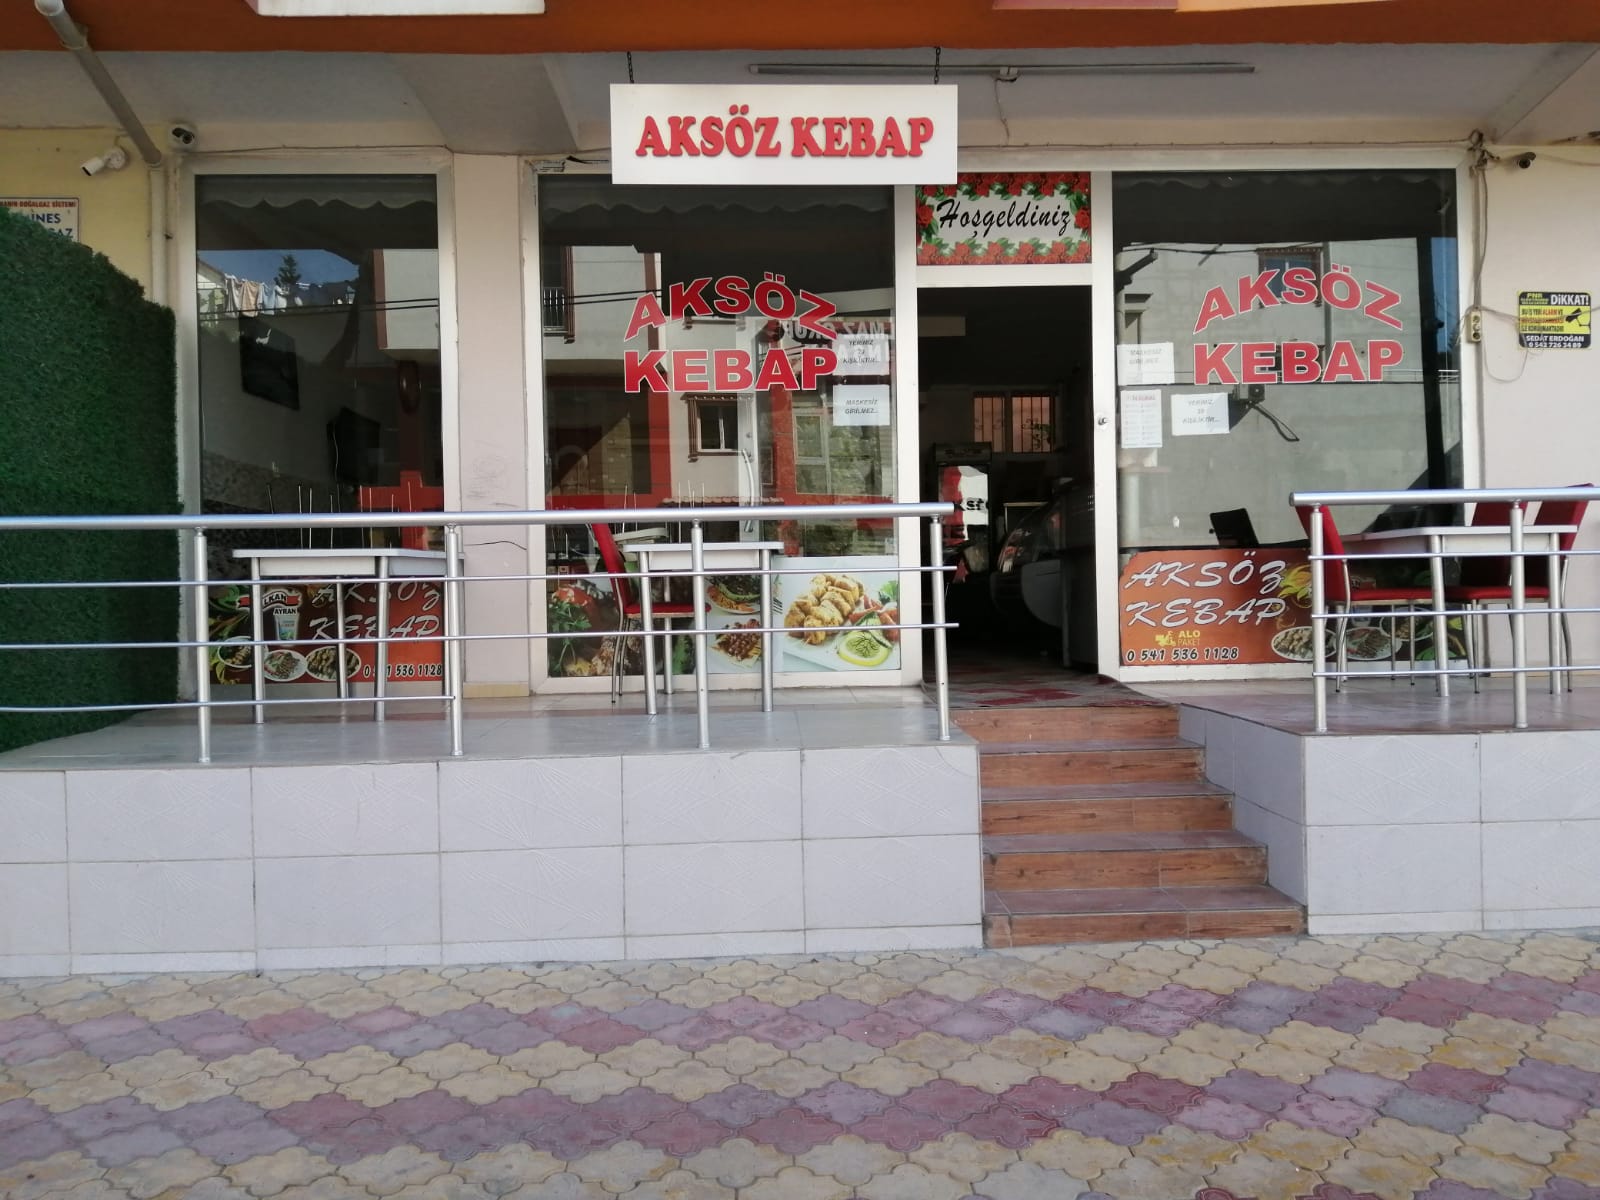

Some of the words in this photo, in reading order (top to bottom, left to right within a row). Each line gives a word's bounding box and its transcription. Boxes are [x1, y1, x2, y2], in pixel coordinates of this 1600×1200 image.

[635, 104, 782, 158] AKSÖZ
[790, 116, 934, 158] KEBAP
[936, 198, 1071, 239] Hoşgeldiniz
[623, 271, 838, 343] AKSÖZ
[1192, 263, 1403, 335] AKSÖZ
[623, 348, 838, 393] KEBAP
[1193, 339, 1404, 385] KEBAP
[1124, 551, 1287, 595] AKSÖZ
[1125, 597, 1286, 628] KEBAP
[1178, 630, 1201, 638] ALO
[395, 663, 414, 678] 536
[1127, 649, 1135, 662] 0
[1141, 648, 1165, 661] 541
[1171, 647, 1198, 661] 536
[1204, 647, 1239, 660] 1128
